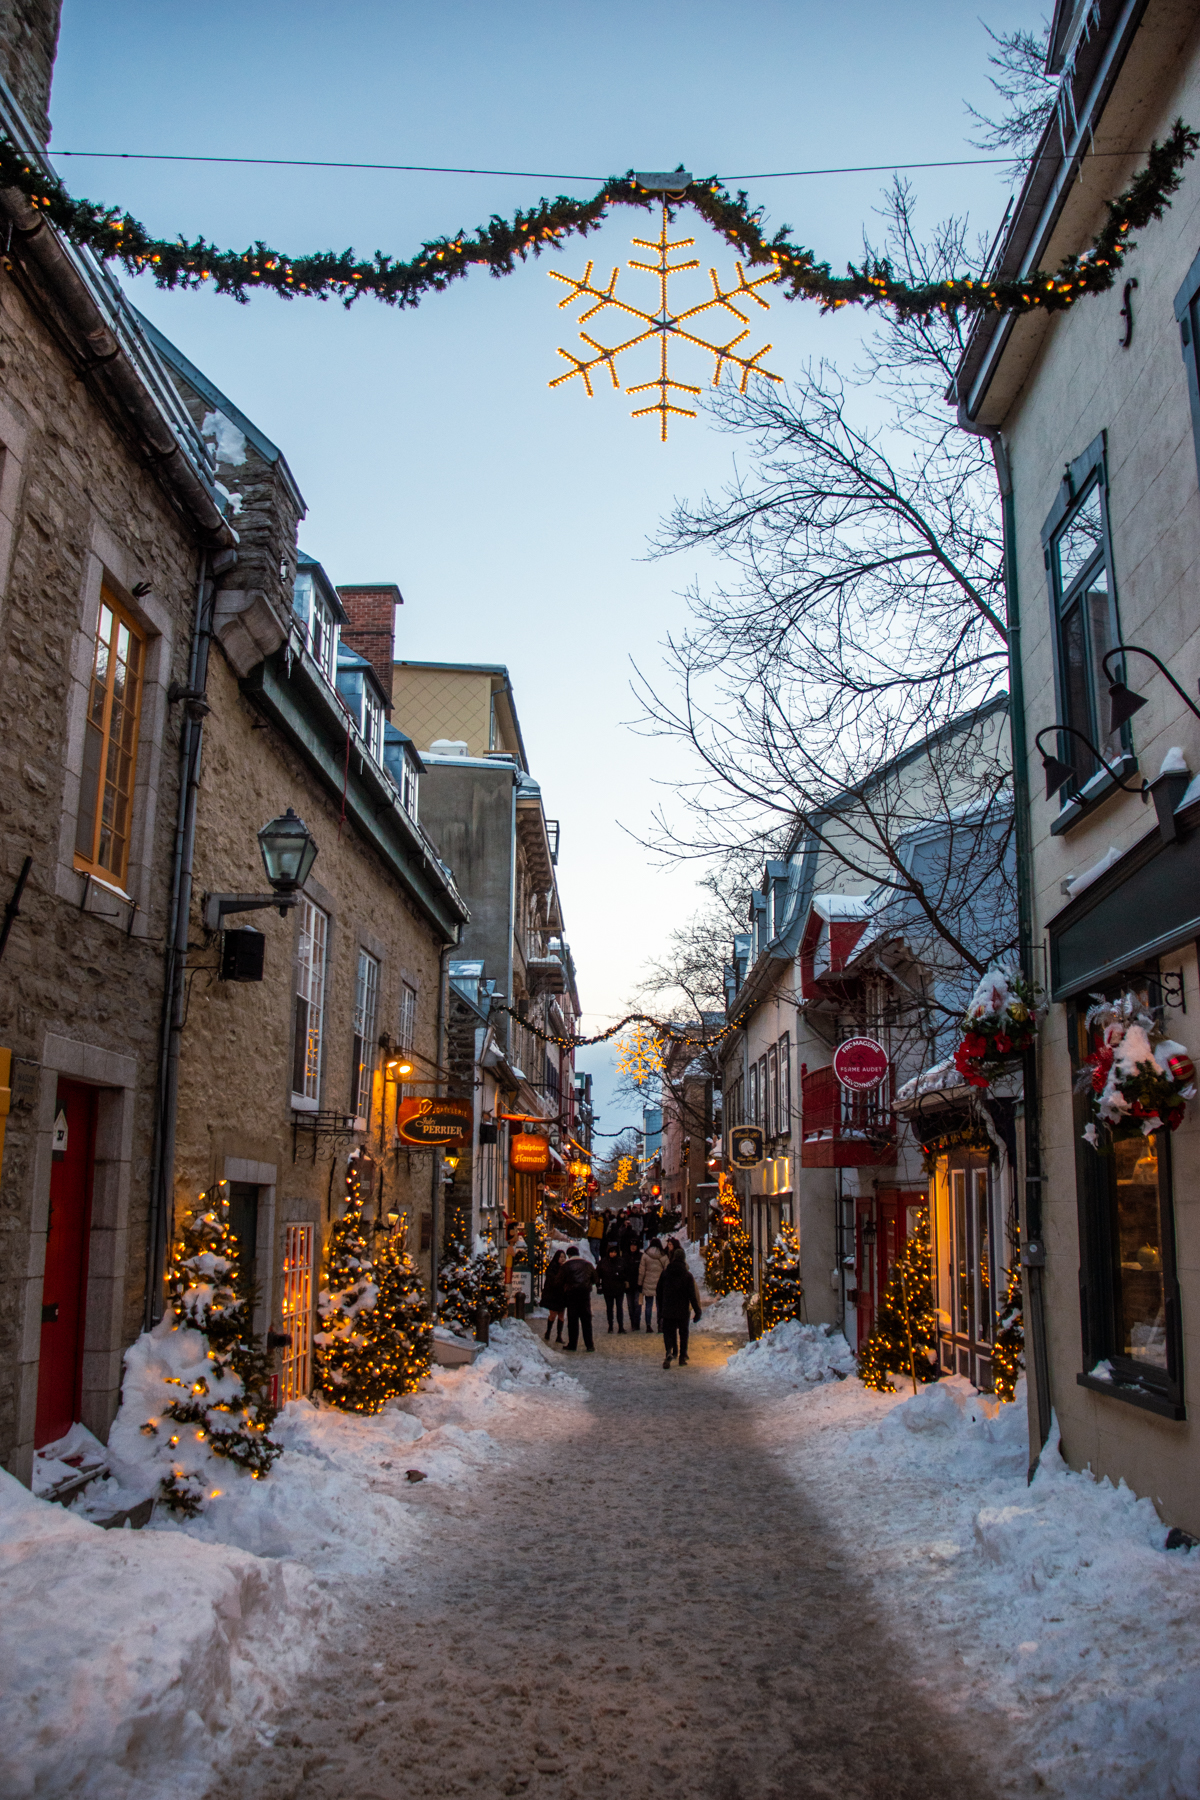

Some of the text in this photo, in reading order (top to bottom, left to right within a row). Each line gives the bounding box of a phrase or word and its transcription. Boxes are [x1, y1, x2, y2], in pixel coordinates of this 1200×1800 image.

[841, 1040, 880, 1054] FROMAGERIE
[842, 1075, 881, 1087] SAVONNERIE
[423, 1125, 464, 1139] PERRIER
